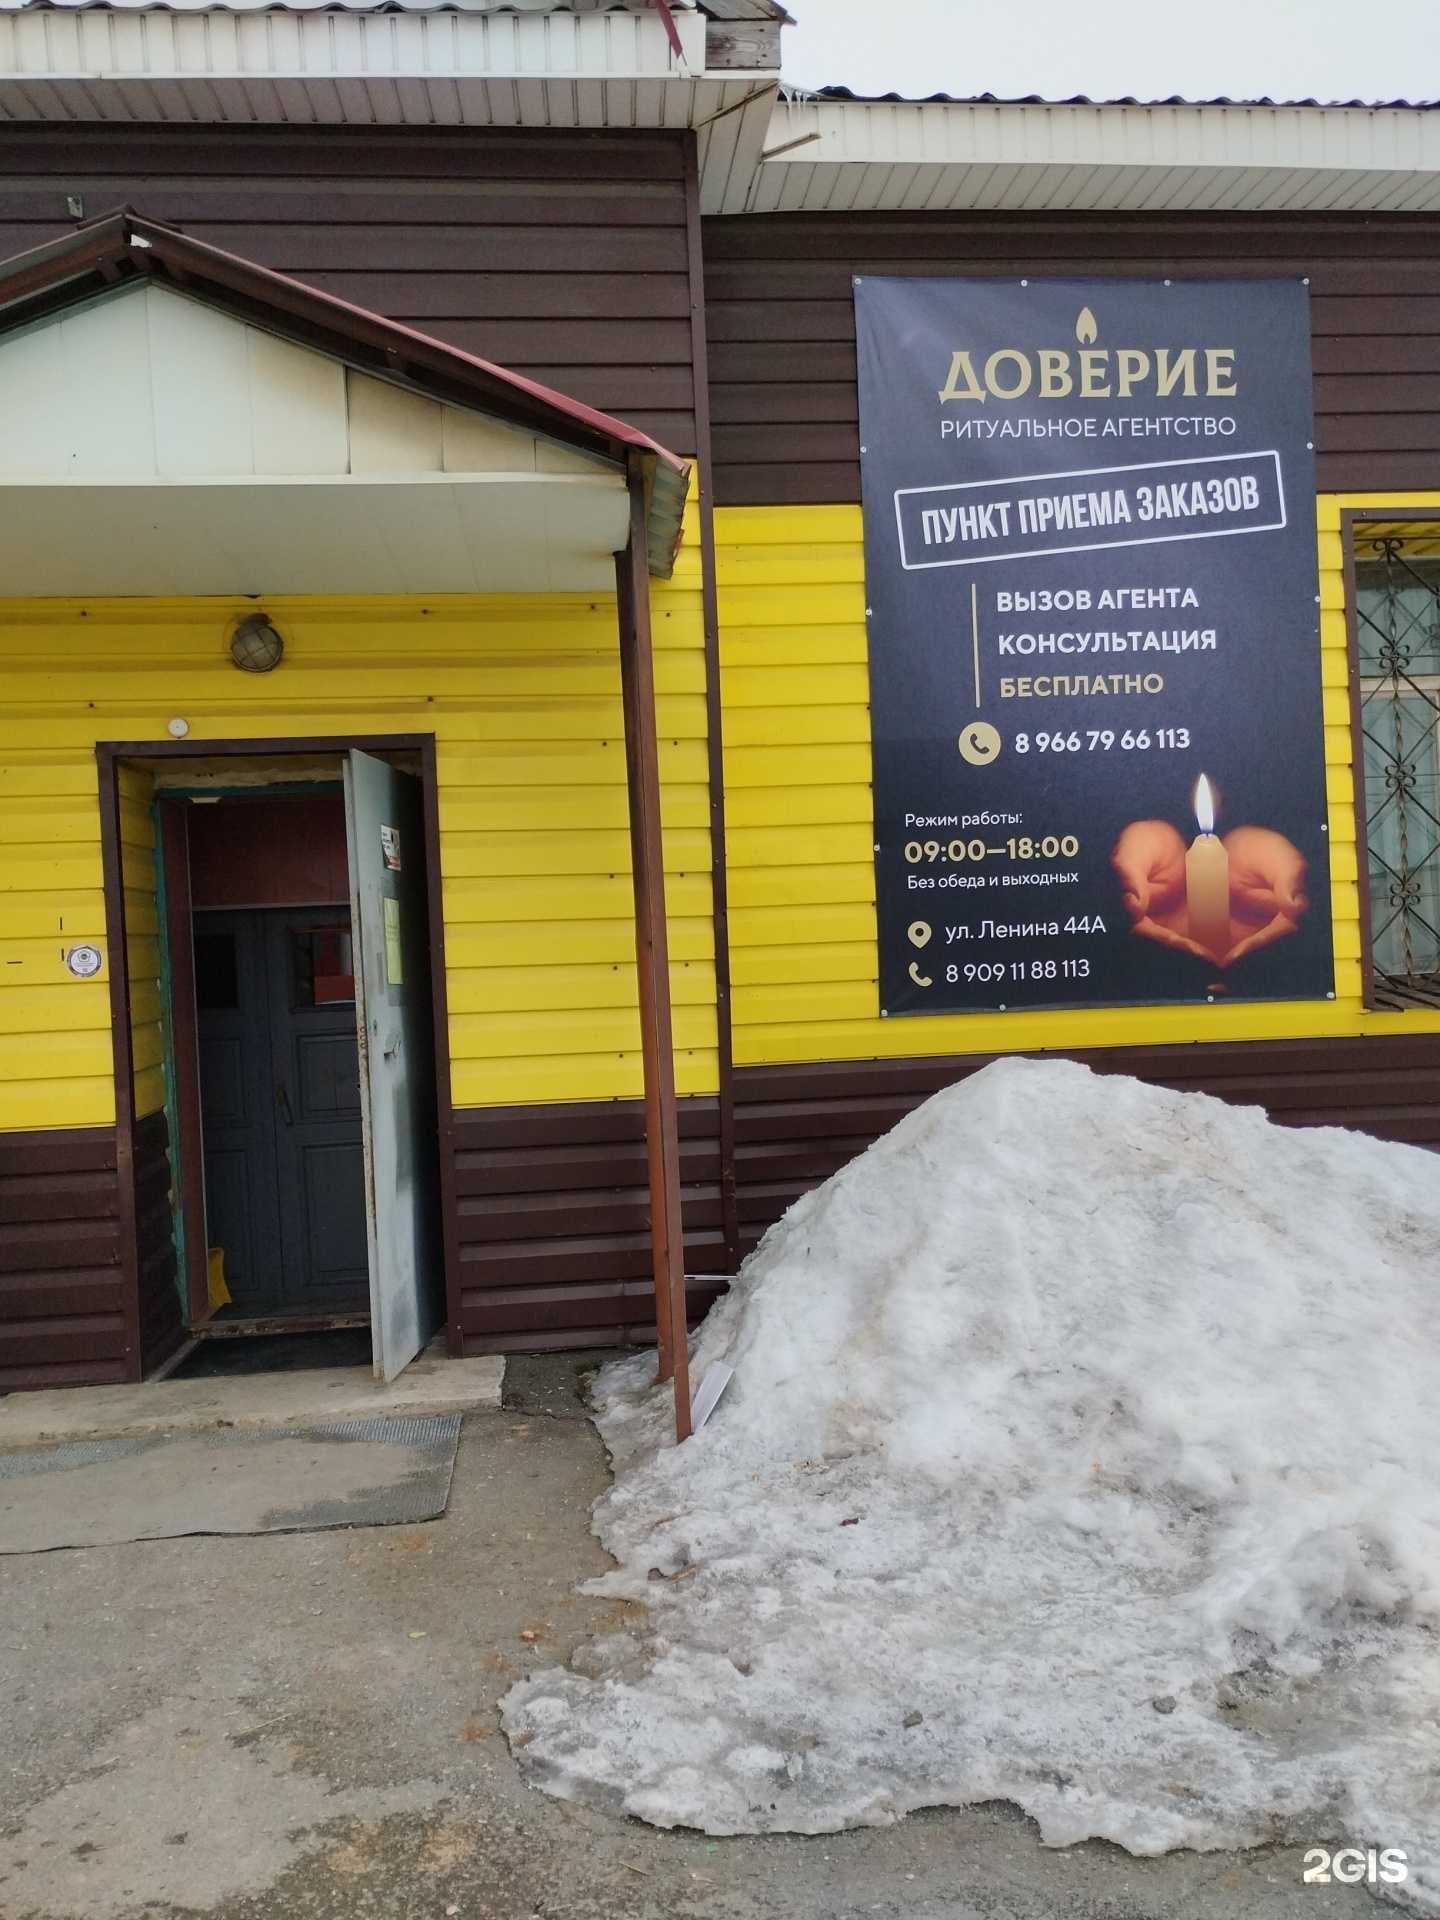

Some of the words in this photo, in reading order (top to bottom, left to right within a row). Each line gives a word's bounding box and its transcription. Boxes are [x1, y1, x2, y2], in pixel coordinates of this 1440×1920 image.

[938, 349, 1238, 405] ДОВЕРИЕ
[941, 418, 1097, 439] РИТУАЛЬНОЕ
[1102, 416, 1237, 437] АГЕНТСТВО
[921, 502, 1011, 545] ПУНКТ
[1018, 489, 1132, 534] ПРИЕМА
[1136, 476, 1260, 522] ЗАКАЗОВ
[996, 590, 1092, 612] ВЫЗОВ
[1097, 587, 1199, 610] АГЕНТА
[998, 630, 1217, 655] КОНСУЛЬТАЦИЯ
[1000, 673, 1164, 698] БЕСПЛАТНО
[1015, 733, 1030, 753] 8
[1035, 731, 1081, 752] 966
[1086, 730, 1115, 751] 79
[1120, 729, 1151, 750] 66
[1156, 728, 1190, 749] 113
[904, 813, 958, 828] Режим
[961, 811, 1023, 829] работы:
[907, 874, 936, 889] Без
[938, 873, 985, 889] обеда
[989, 875, 998, 886] и
[1002, 870, 1078, 887] выходных
[945, 925, 974, 942] ул.
[980, 919, 1059, 939] Ленина
[1063, 916, 1107, 934] 44А
[946, 965, 958, 982] 8
[963, 963, 1005, 981] 909
[1010, 962, 1026, 980] 11
[1030, 961, 1056, 979] 88
[1061, 959, 1090, 978] 113
